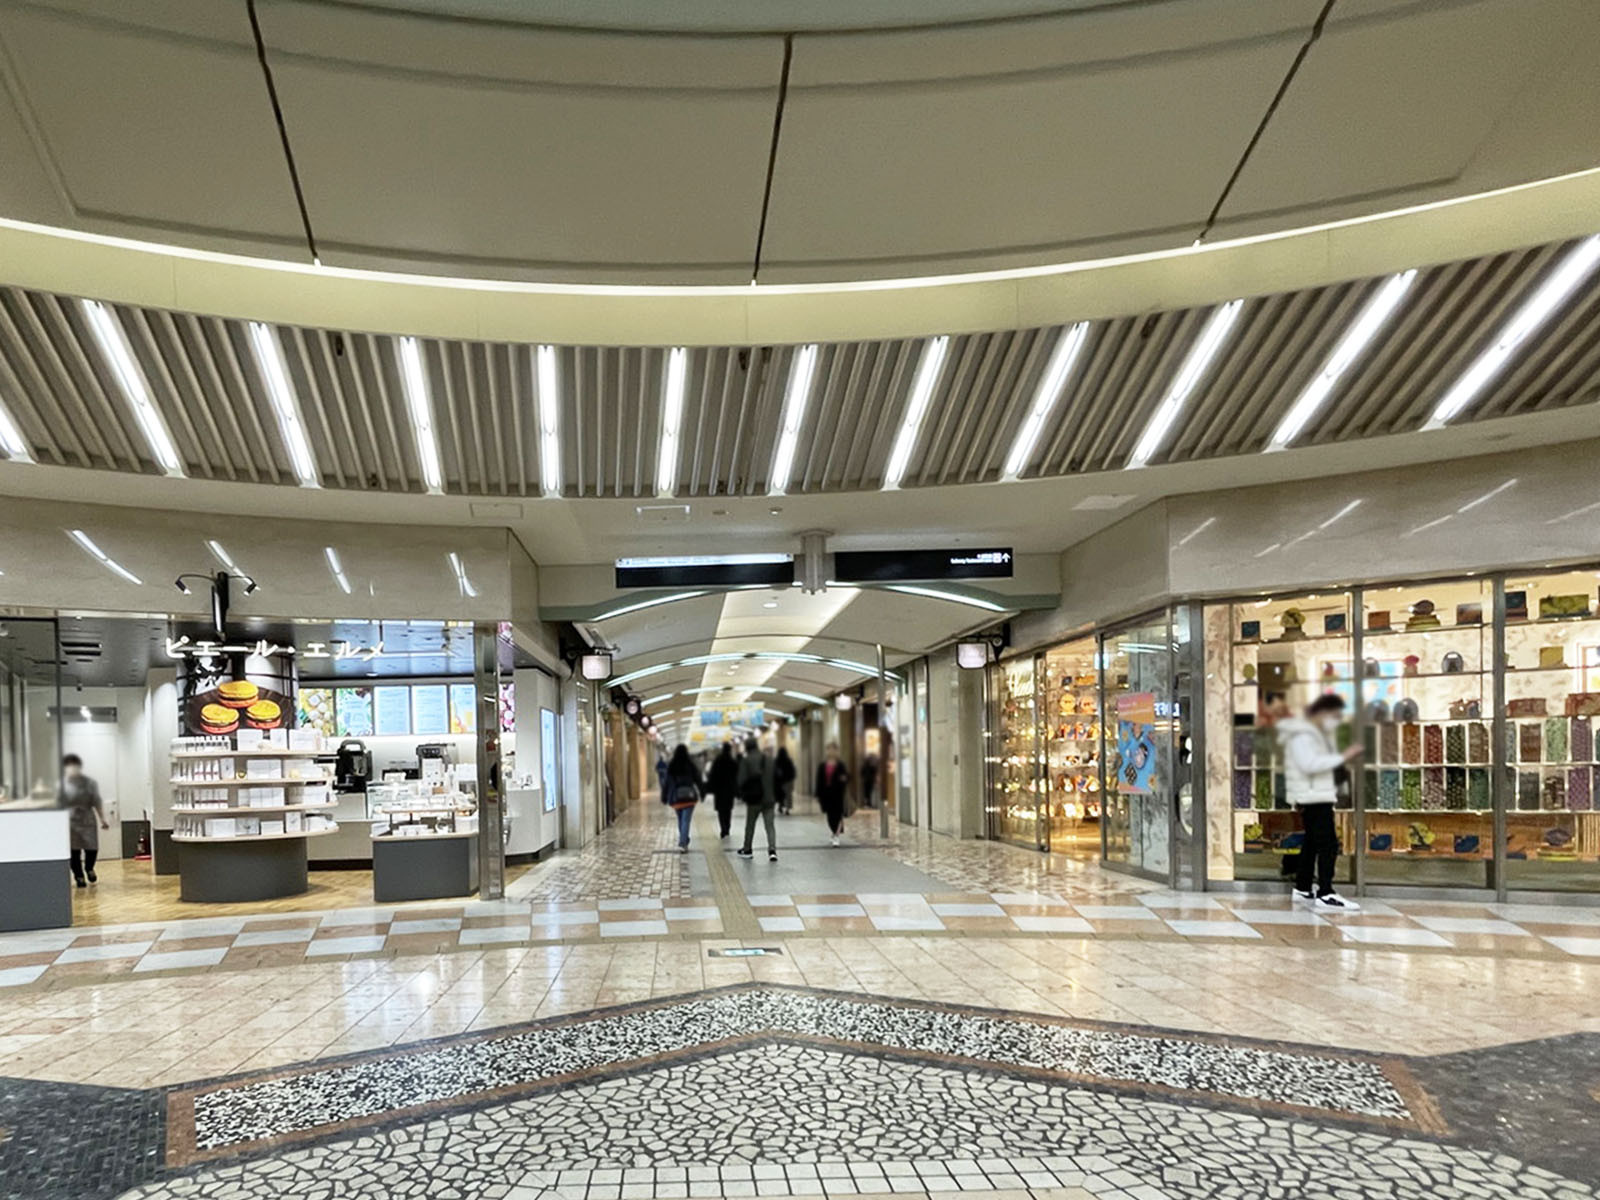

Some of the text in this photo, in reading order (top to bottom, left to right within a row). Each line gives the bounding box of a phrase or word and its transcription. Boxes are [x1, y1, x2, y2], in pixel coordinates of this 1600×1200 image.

[165, 635, 385, 663] ピエール・エルメ
